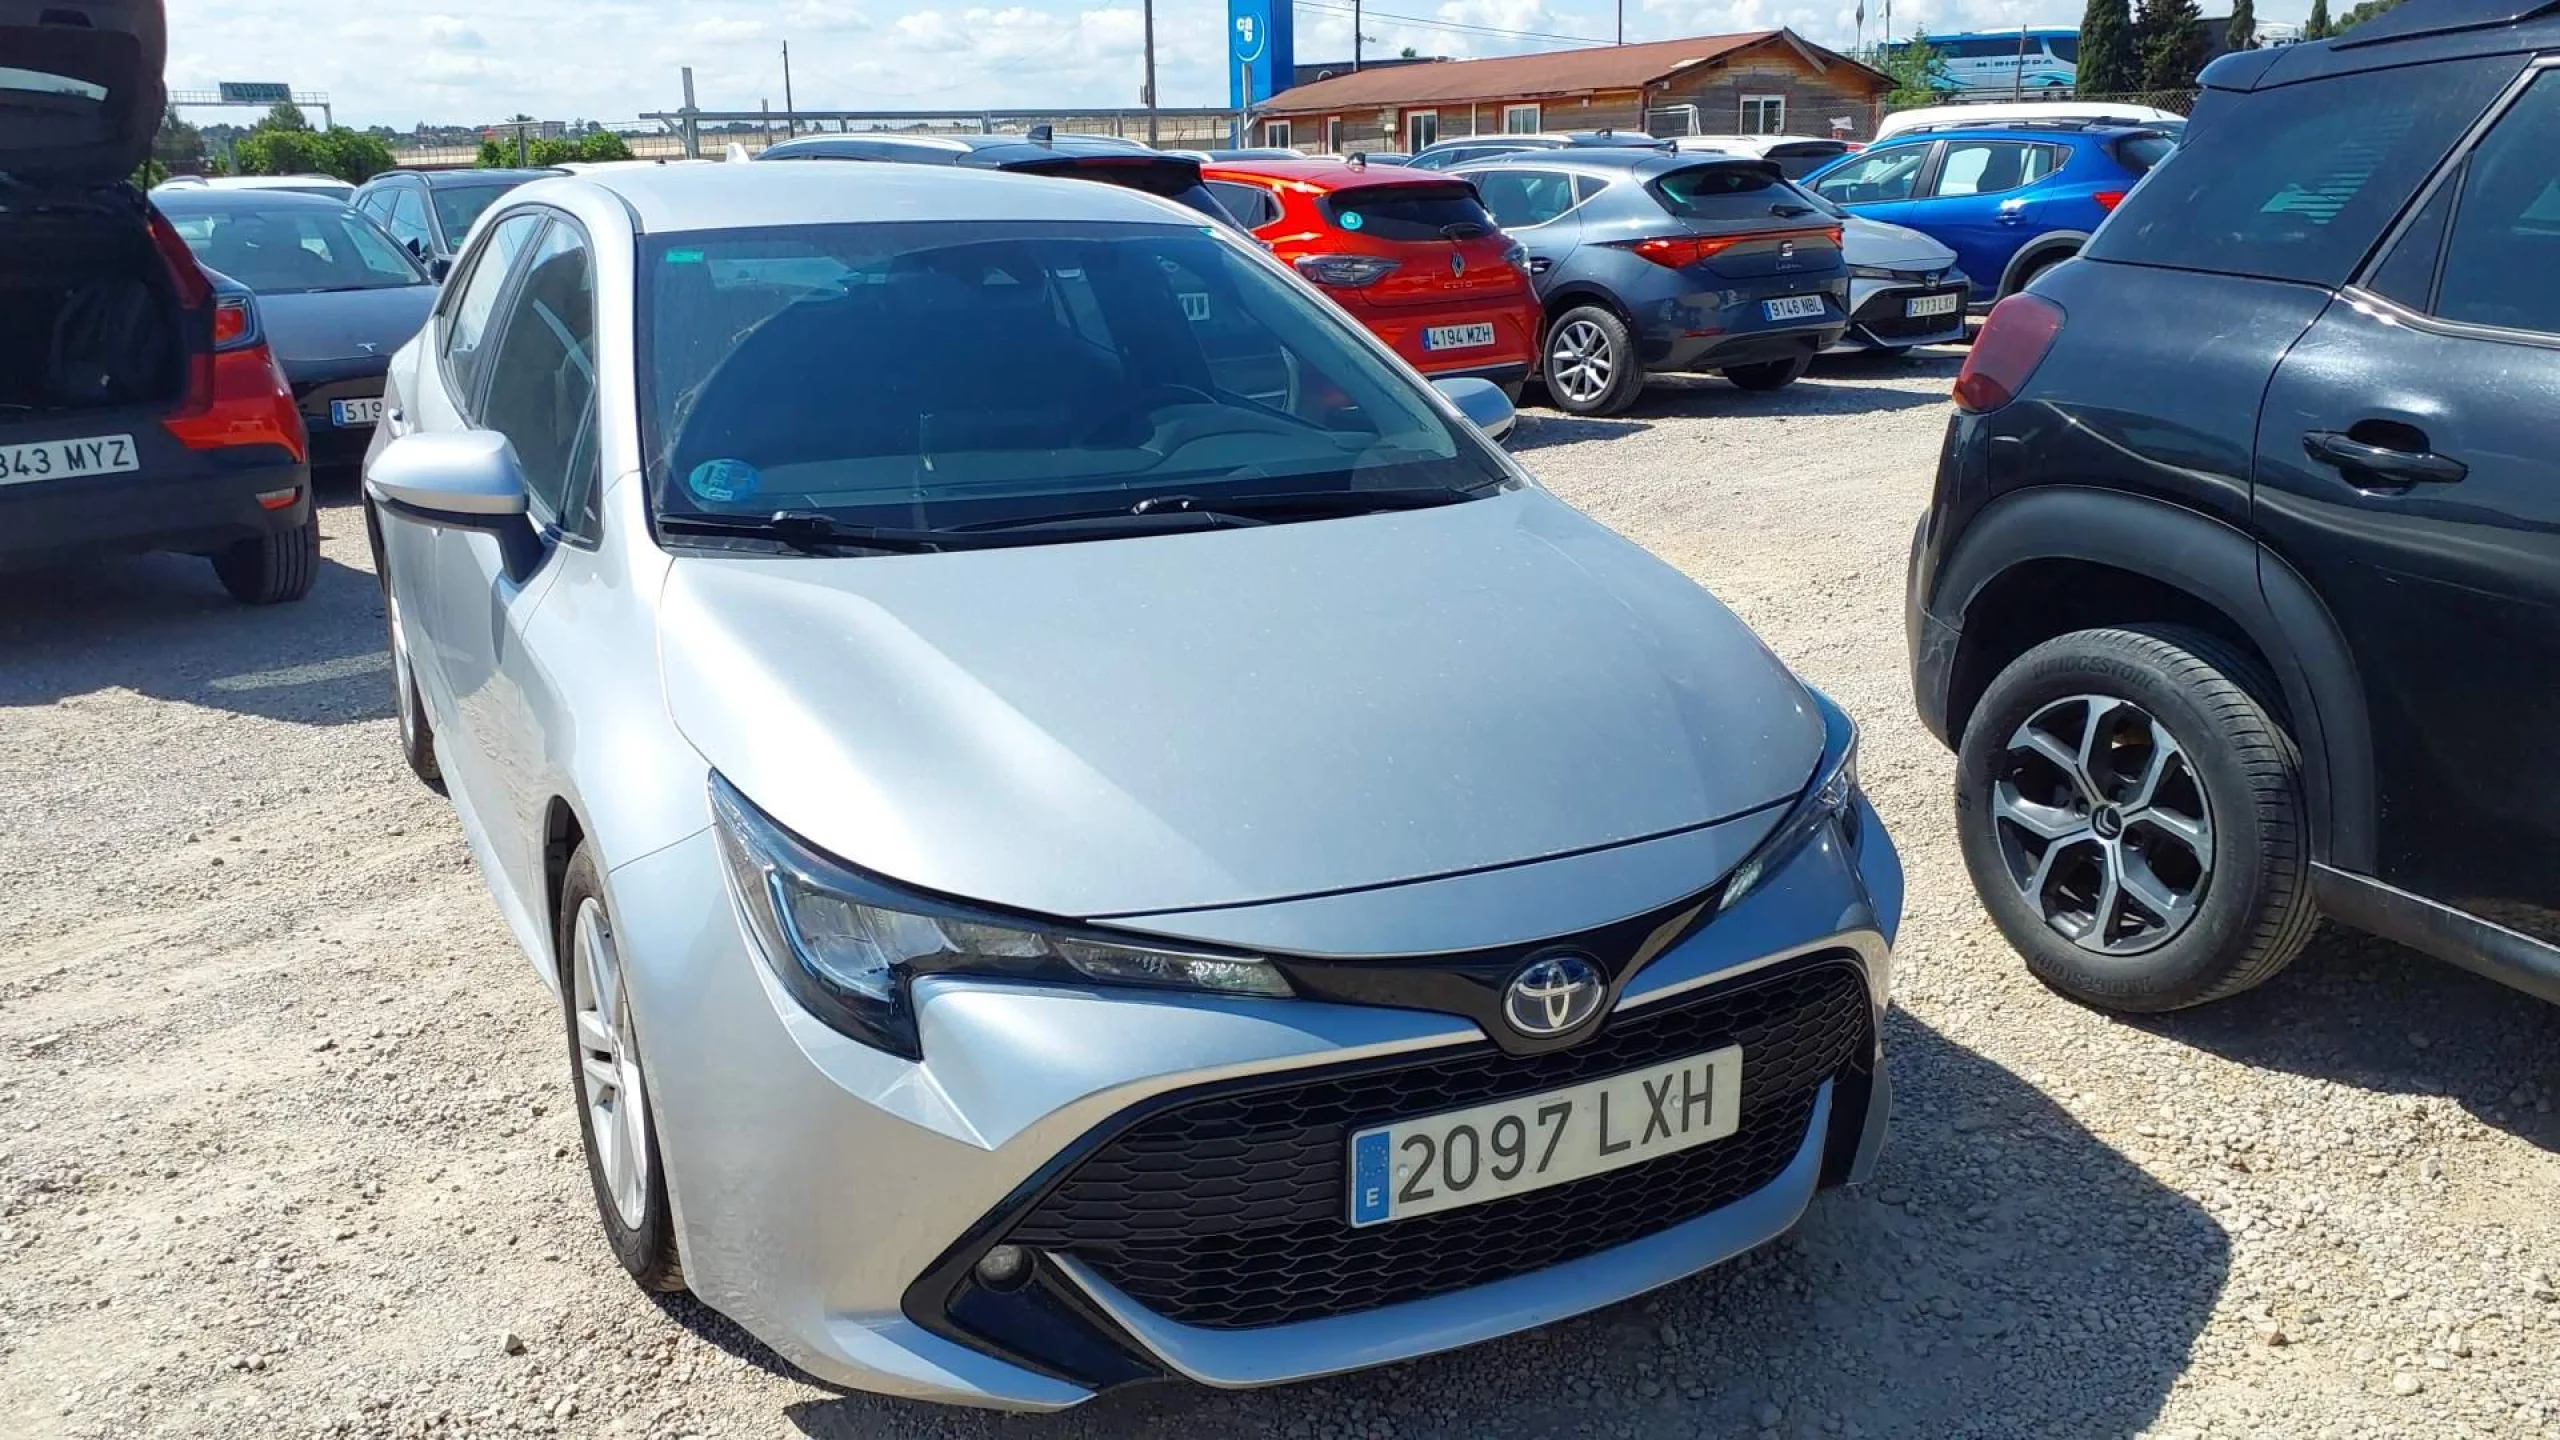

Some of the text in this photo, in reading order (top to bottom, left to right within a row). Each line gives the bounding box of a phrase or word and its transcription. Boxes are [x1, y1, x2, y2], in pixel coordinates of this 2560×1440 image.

[1771, 297, 1823, 317] 9146 NBL
[1432, 325, 1492, 346] 4194 MZH
[345, 401, 382, 421] 519
[64, 440, 130, 471] MYZ
[1366, 1063, 1714, 1207] E 2097 LXH
